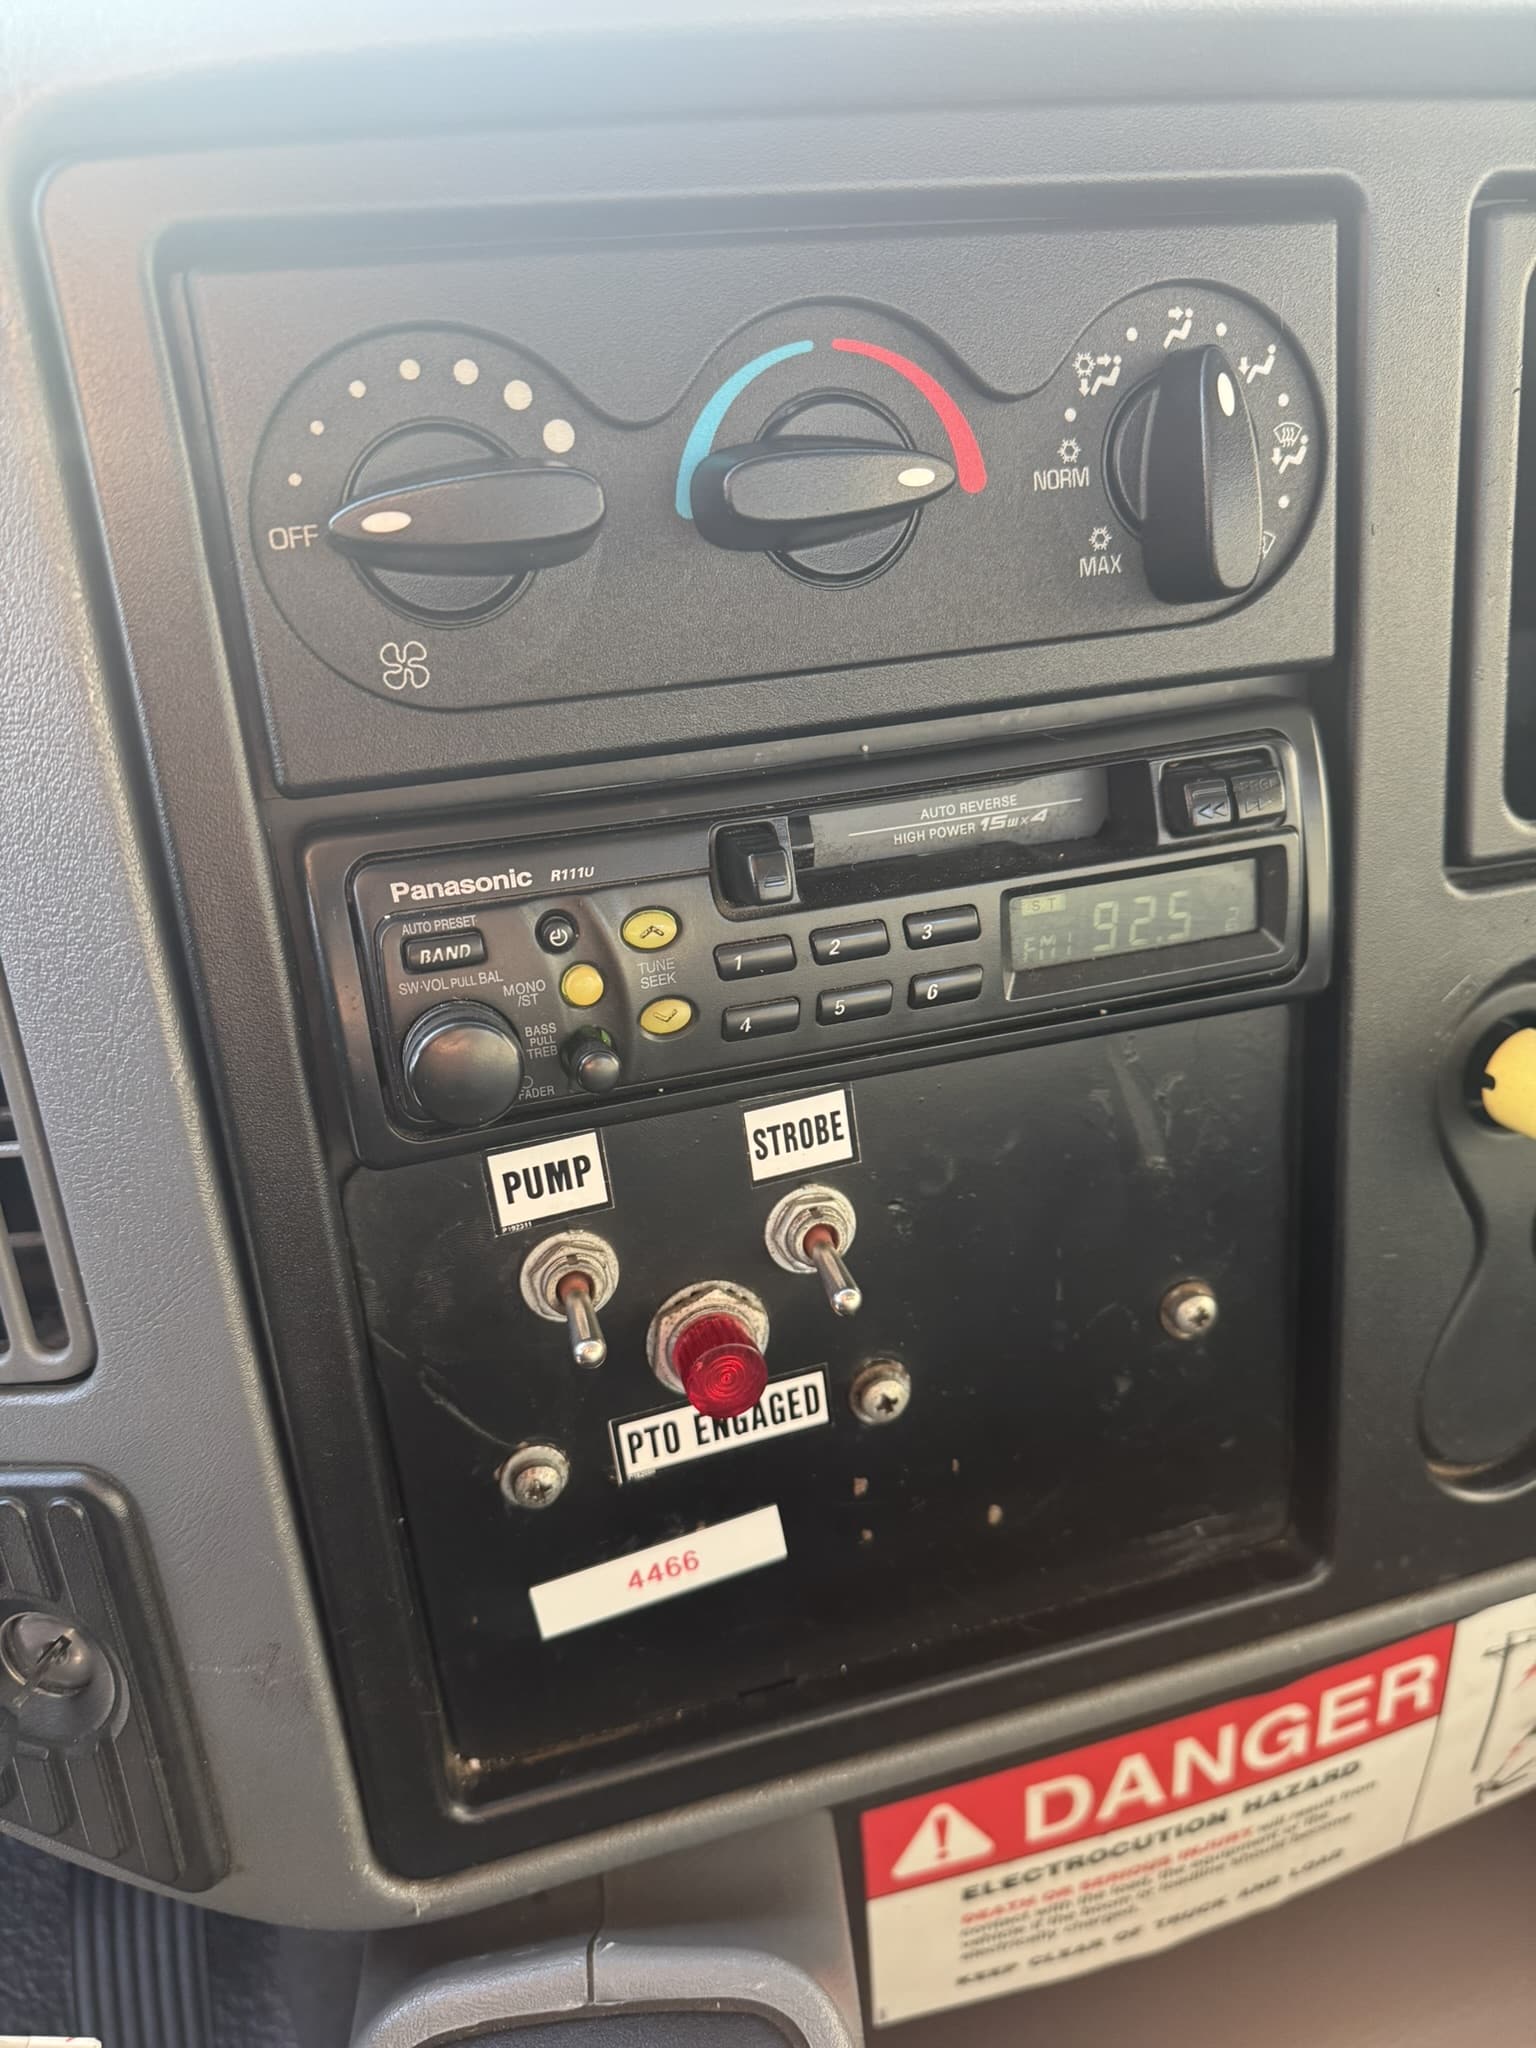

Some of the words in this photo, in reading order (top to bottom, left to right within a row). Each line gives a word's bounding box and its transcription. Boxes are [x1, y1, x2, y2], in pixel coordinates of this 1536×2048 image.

[1033, 466, 1090, 491] NORM
[268, 524, 319, 550] OFF
[1079, 554, 1122, 578] MAX
[920, 804, 956, 820] AUTO
[960, 794, 1017, 814] REVERSE
[894, 830, 926, 845] HIGH
[929, 823, 976, 840] POWER
[390, 868, 533, 903] Panasonic
[551, 866, 595, 883] R111U
[401, 919, 432, 936] AUTO
[434, 914, 477, 932] PRESET
[1093, 890, 1192, 951] 92.5
[921, 924, 933, 940] 3
[420, 944, 471, 964] BAND
[829, 939, 841, 956] 2
[637, 958, 675, 975] TUNE
[733, 955, 743, 971] 1
[450, 974, 477, 989] PULL
[479, 970, 504, 985] BAL
[503, 979, 546, 997] MONO
[640, 973, 677, 990] SEEK
[927, 984, 939, 1000] 6
[834, 1000, 845, 1016] 5
[525, 1022, 557, 1038] BASS
[739, 1016, 752, 1033] 4
[530, 1035, 556, 1047] PULL
[526, 1045, 558, 1060] TREB
[518, 1085, 555, 1101] FADER
[752, 1110, 844, 1160] STROBE
[502, 1154, 593, 1205] PUMP
[627, 1421, 680, 1464] PTO
[627, 1549, 701, 1591] 4466
[1024, 1654, 1440, 1844] DANGER
[961, 1808, 1229, 1901] ELECTROCUTION
[1242, 1760, 1362, 1815] HAZARD
